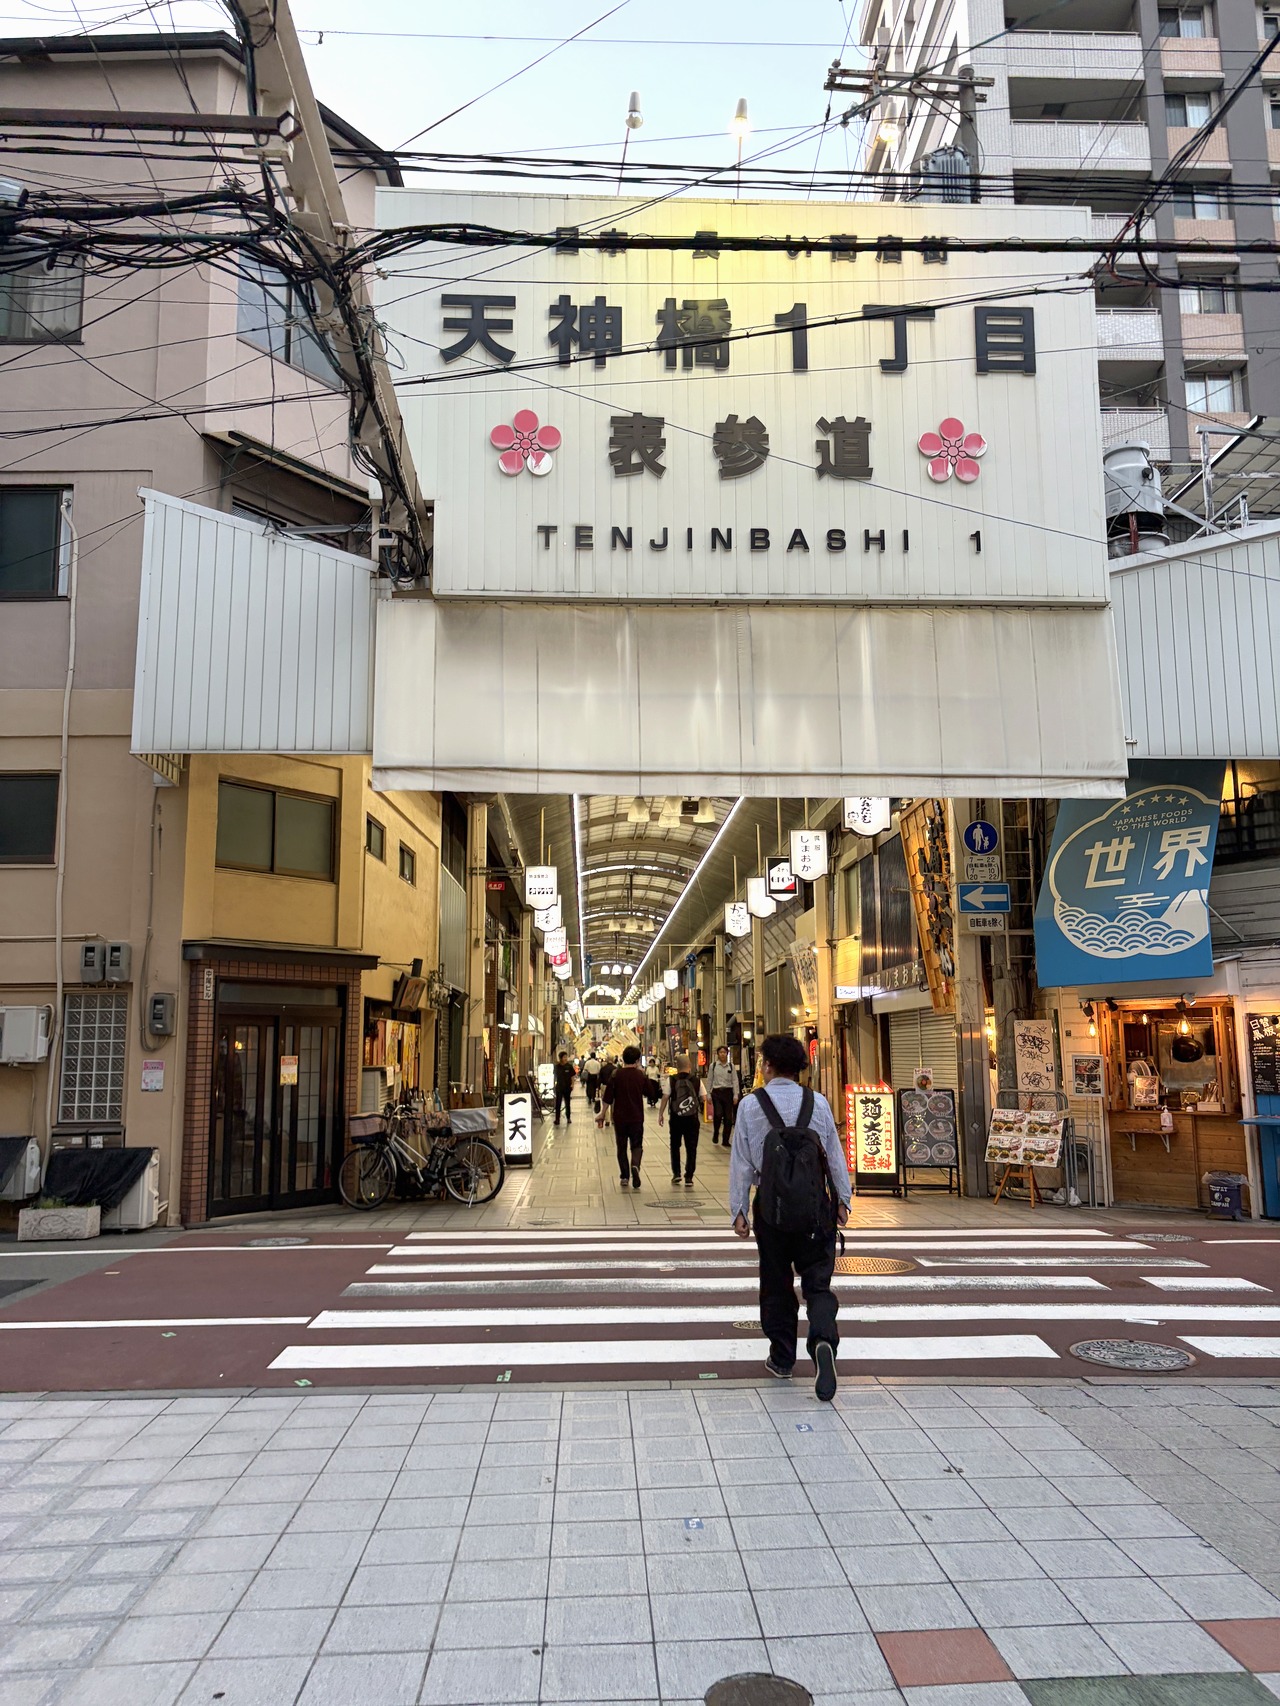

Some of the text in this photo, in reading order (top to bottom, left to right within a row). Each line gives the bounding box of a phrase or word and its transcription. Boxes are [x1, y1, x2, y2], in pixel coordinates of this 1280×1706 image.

[439, 294, 1037, 377] 天神橋1丁目
[608, 412, 874, 481] 表参道
[537, 525, 982, 554] TENJINBASHI 1
[1112, 808, 1193, 827] JAPANESE FOODS
[1153, 816, 1187, 827] WORLD
[800, 835, 811, 872] しまおか
[1084, 825, 1211, 889] 世界
[970, 918, 1003, 927] 自転車を除く
[508, 1097, 527, 1140] 一天
[862, 1154, 892, 1170] 無料
